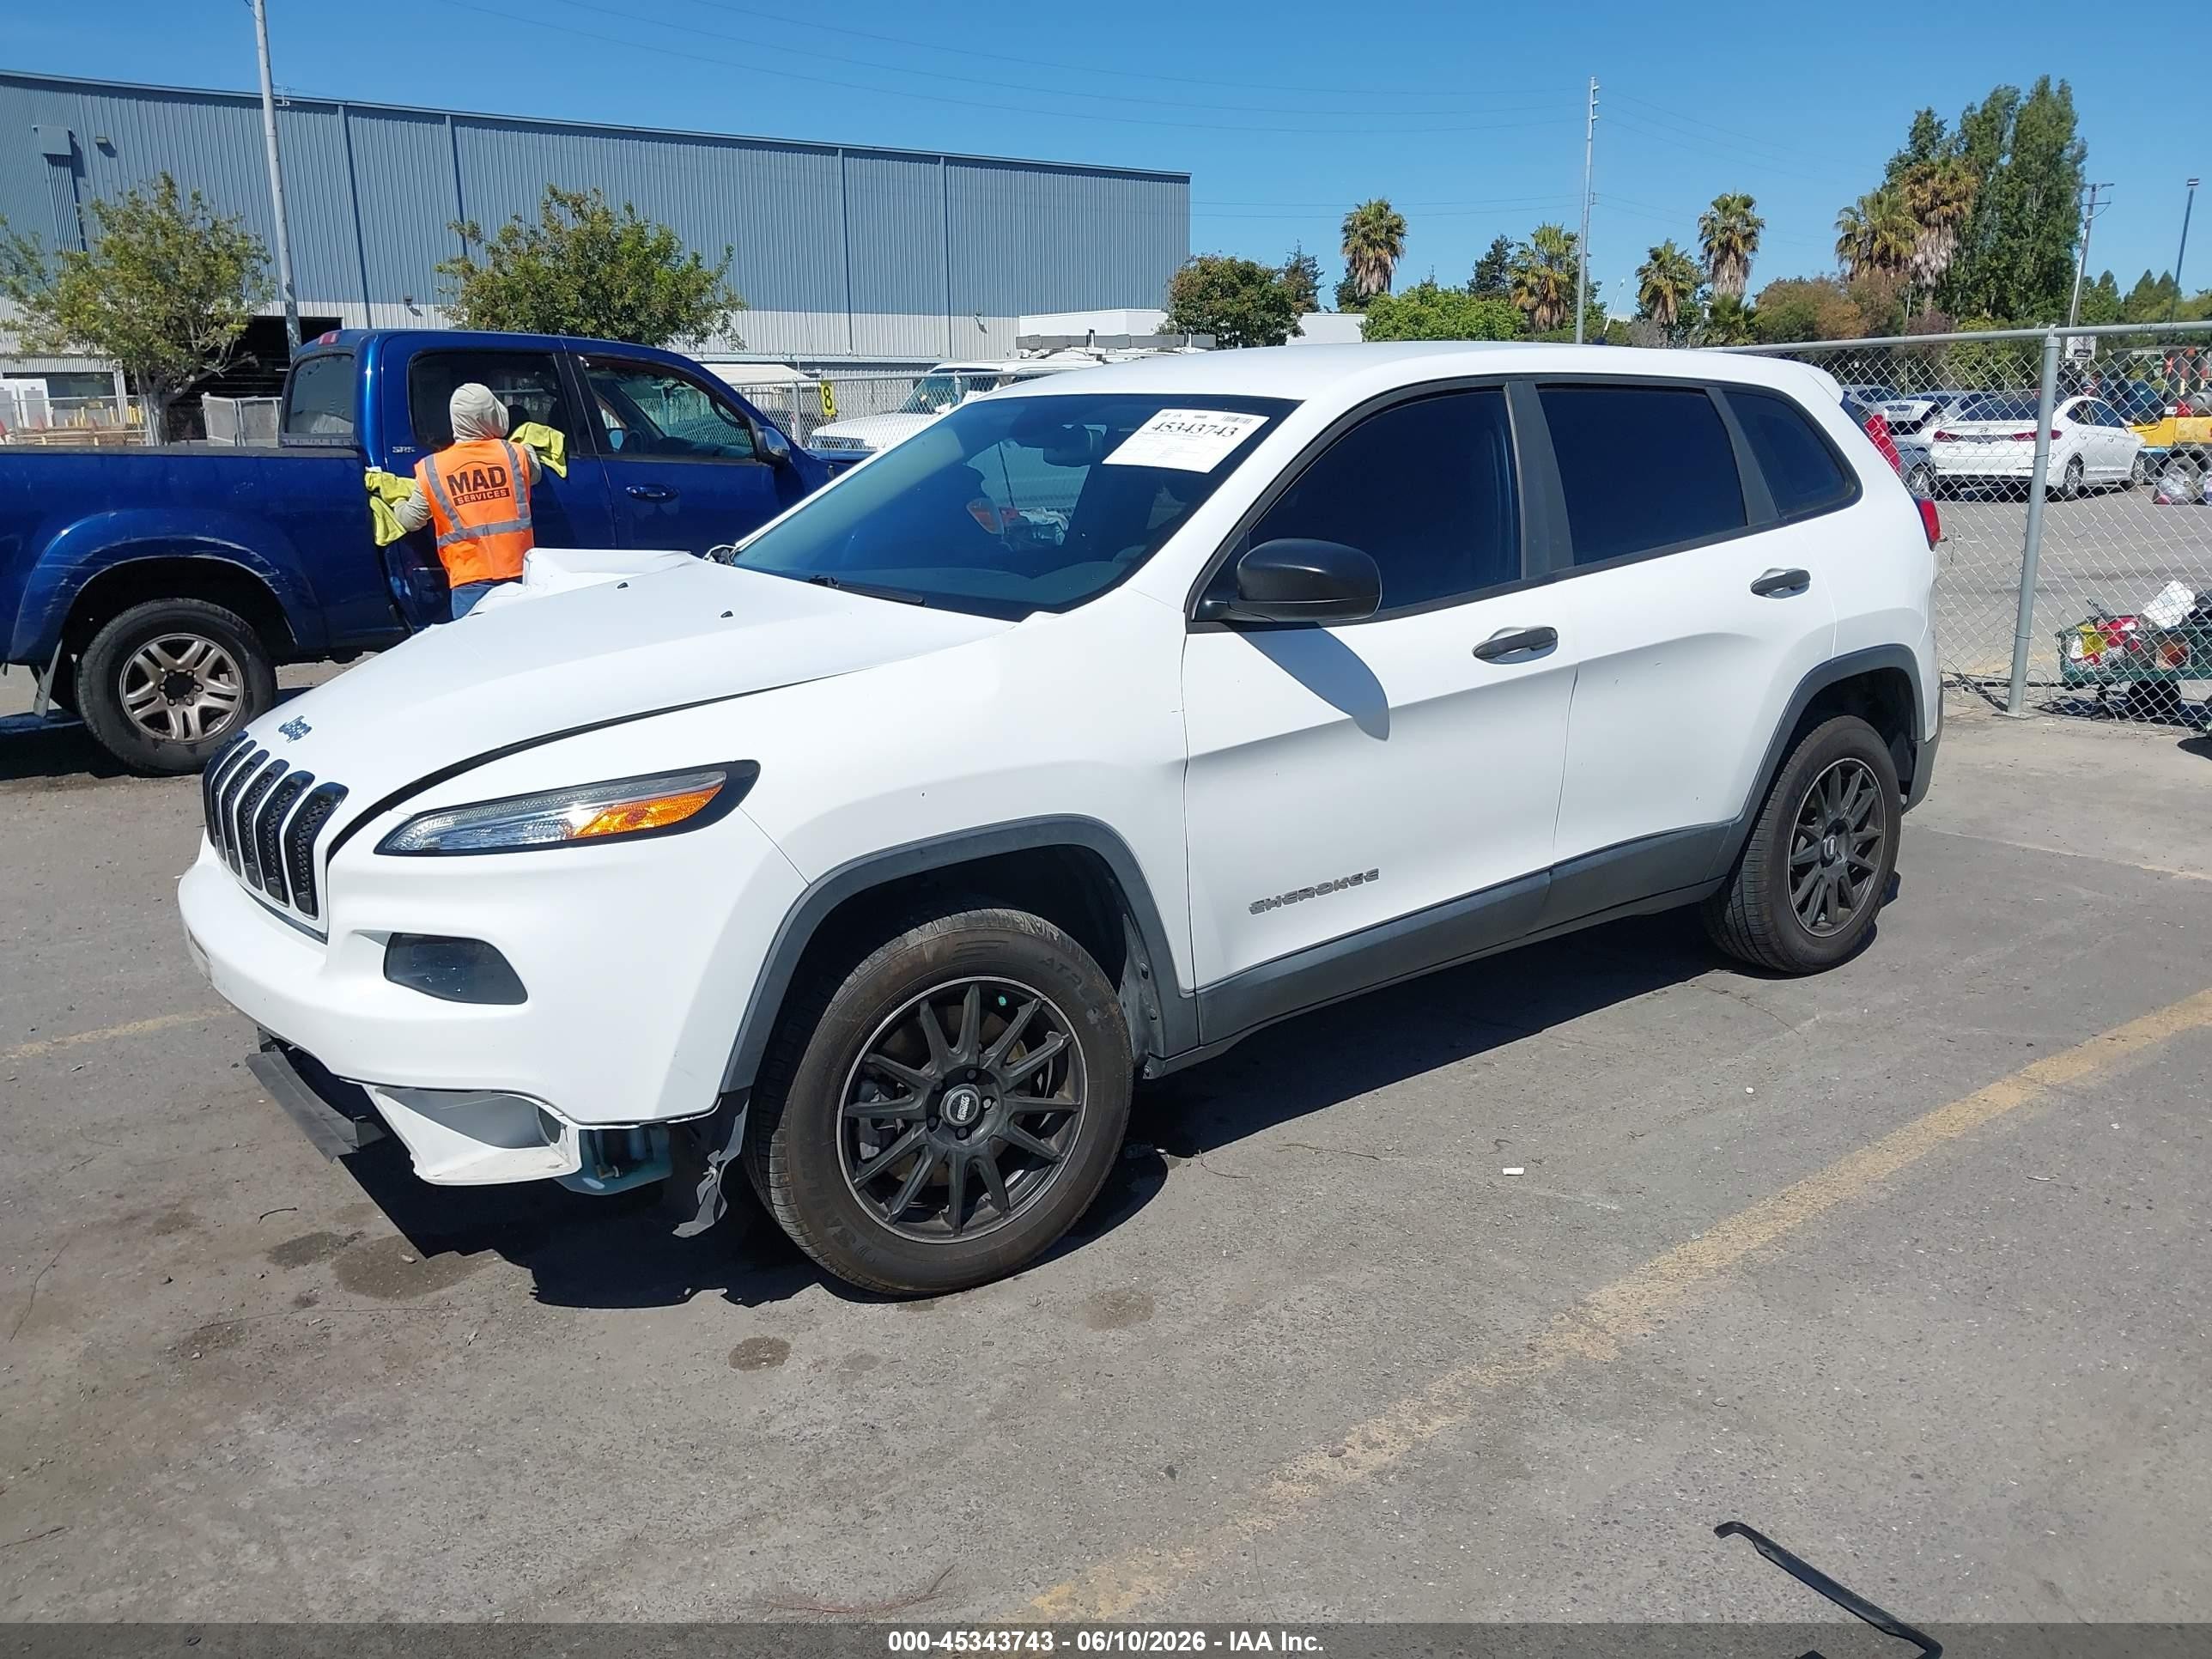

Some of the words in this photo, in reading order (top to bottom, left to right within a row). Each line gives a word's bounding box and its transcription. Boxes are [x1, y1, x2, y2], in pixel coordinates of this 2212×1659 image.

[823, 386, 832, 410] 8
[1152, 422, 1238, 438] 45343743
[447, 465, 507, 496] MAD
[457, 489, 507, 505] SERVICES
[1249, 867, 1379, 915] CHEROKEE
